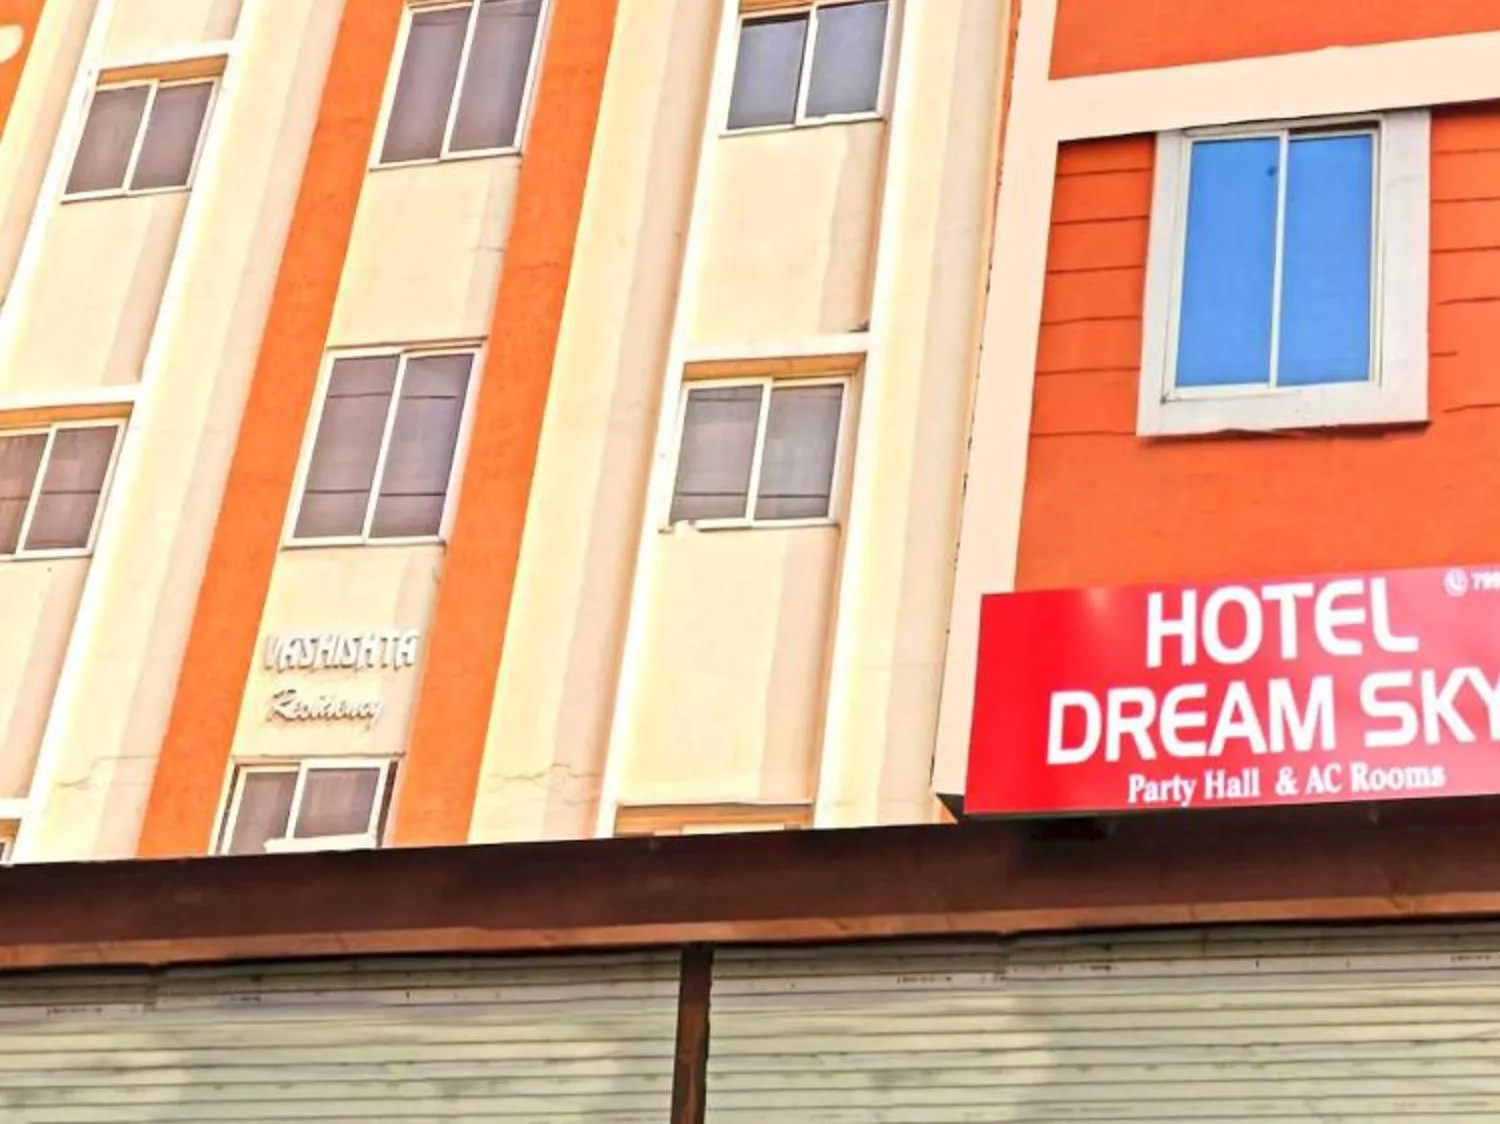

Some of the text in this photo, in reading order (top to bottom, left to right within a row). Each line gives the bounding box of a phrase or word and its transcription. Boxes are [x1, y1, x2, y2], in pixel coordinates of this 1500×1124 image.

[1145, 577, 1421, 668] HOTEL
[1046, 673, 1337, 765] DREAM
[1127, 762, 1447, 807] Party Hall & AC Rooms
